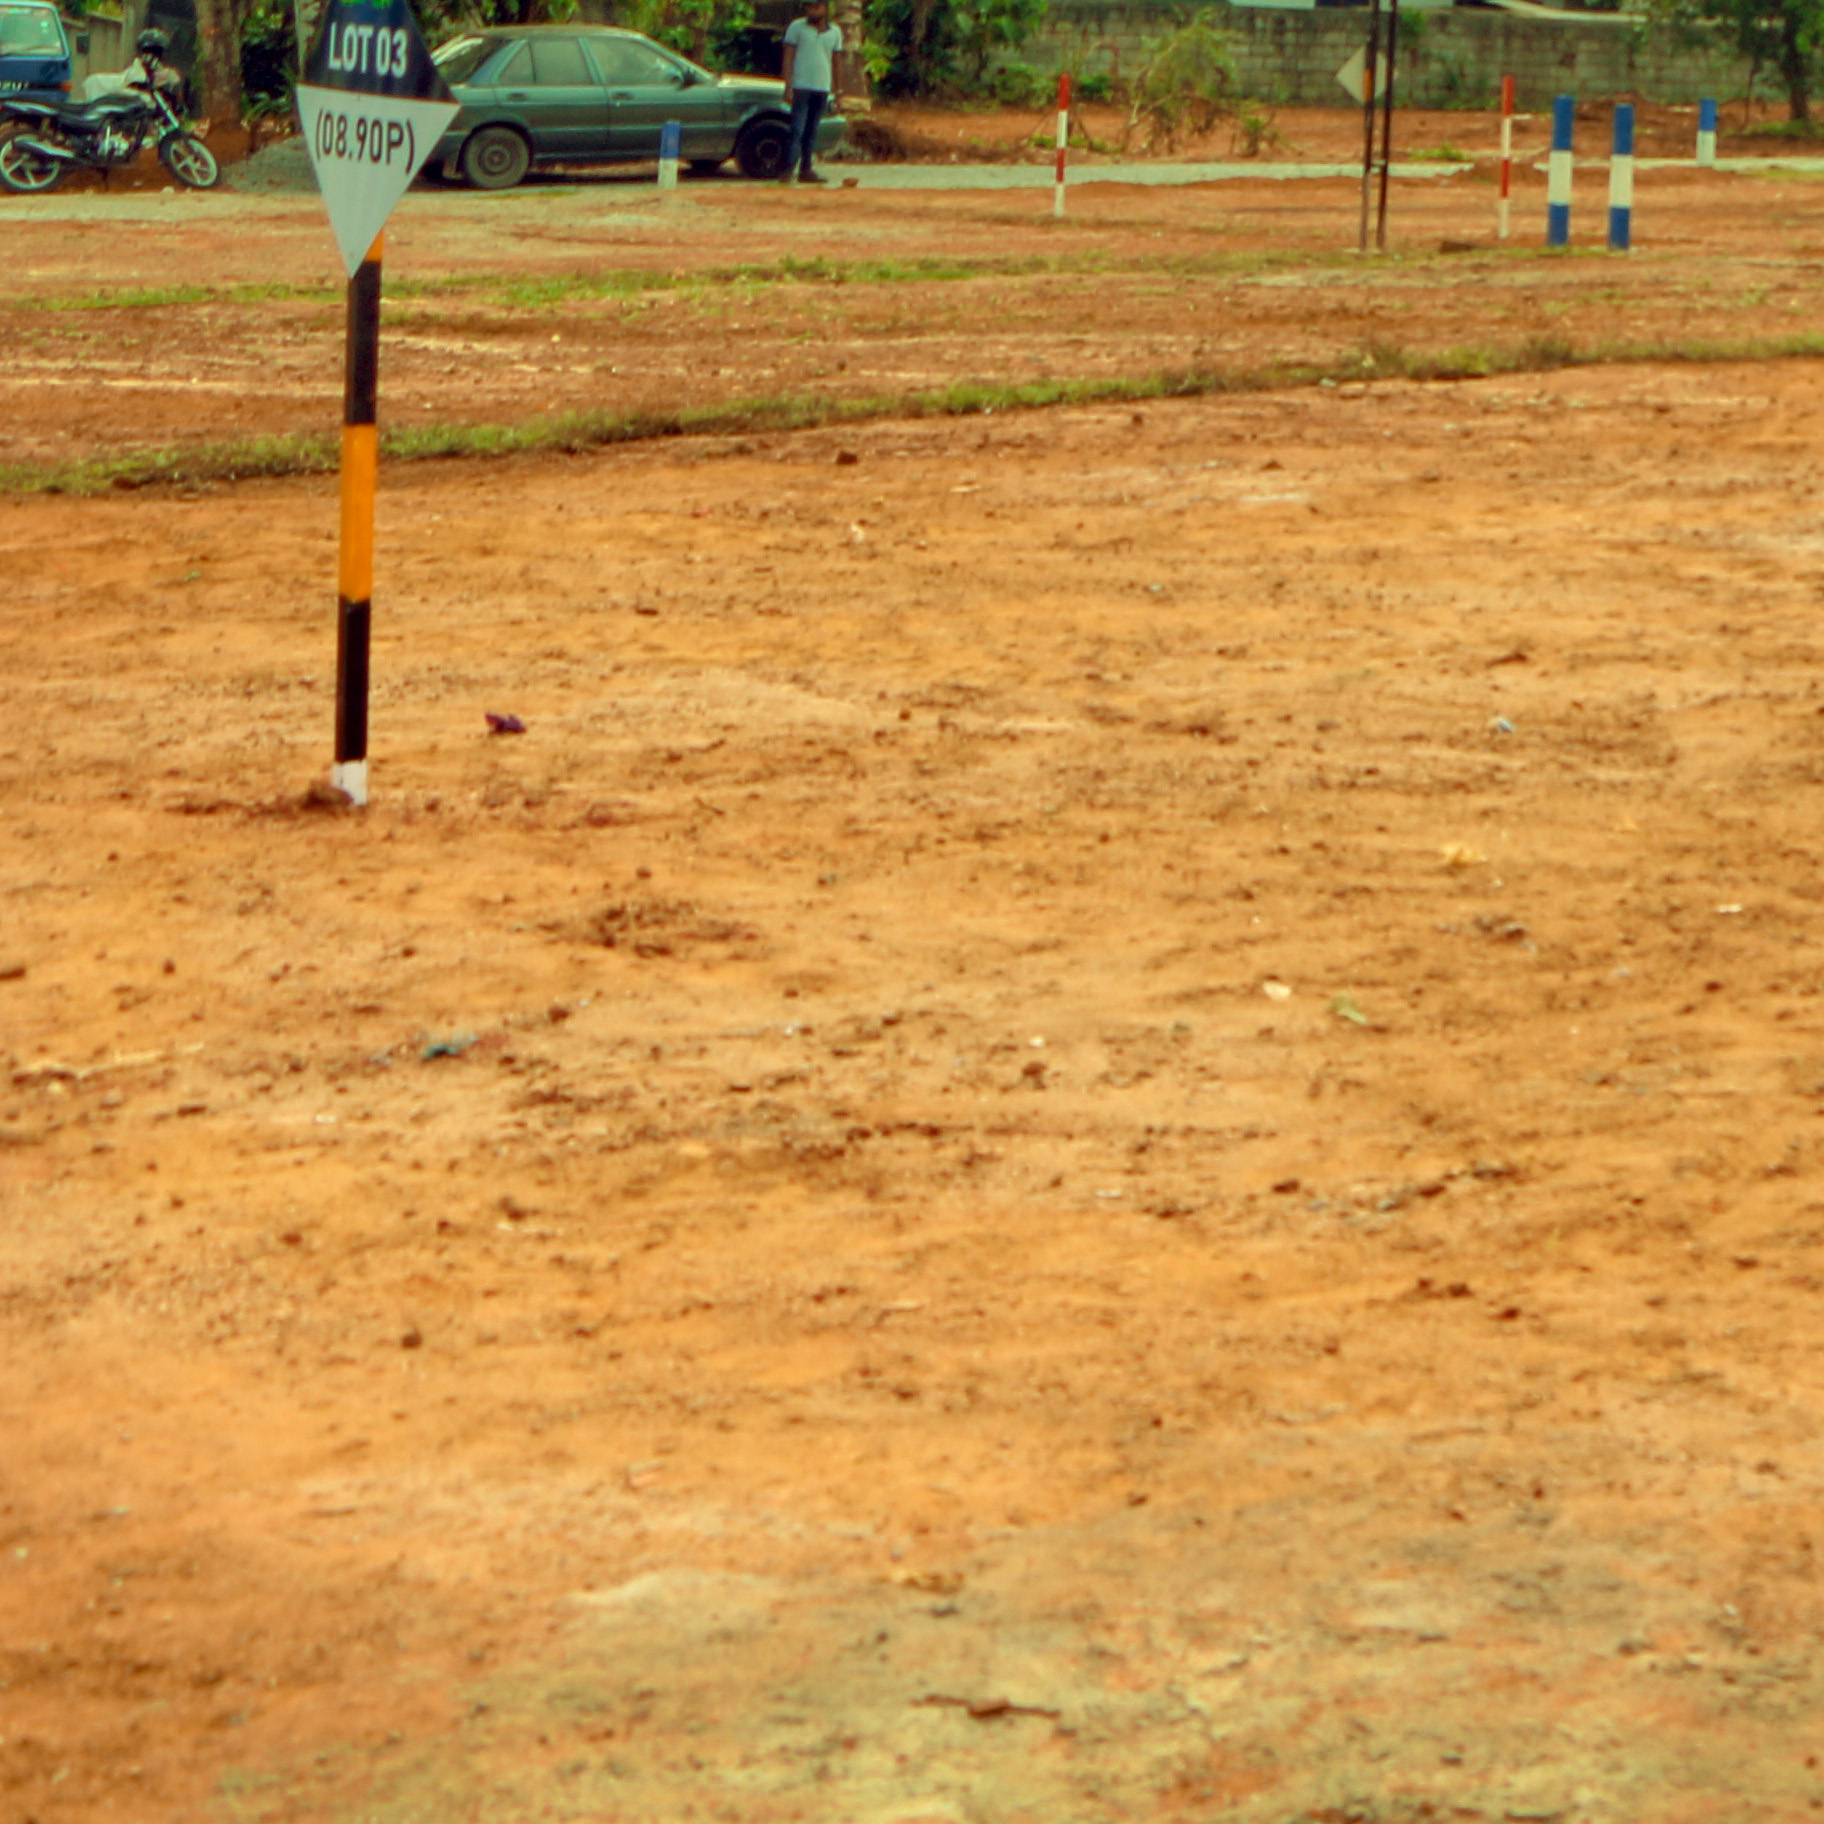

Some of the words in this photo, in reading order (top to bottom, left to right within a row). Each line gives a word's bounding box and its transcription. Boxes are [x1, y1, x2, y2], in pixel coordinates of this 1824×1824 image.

[328, 22, 373, 74] LOT
[376, 26, 408, 78] 03
[315, 108, 415, 175] (08.90P)
